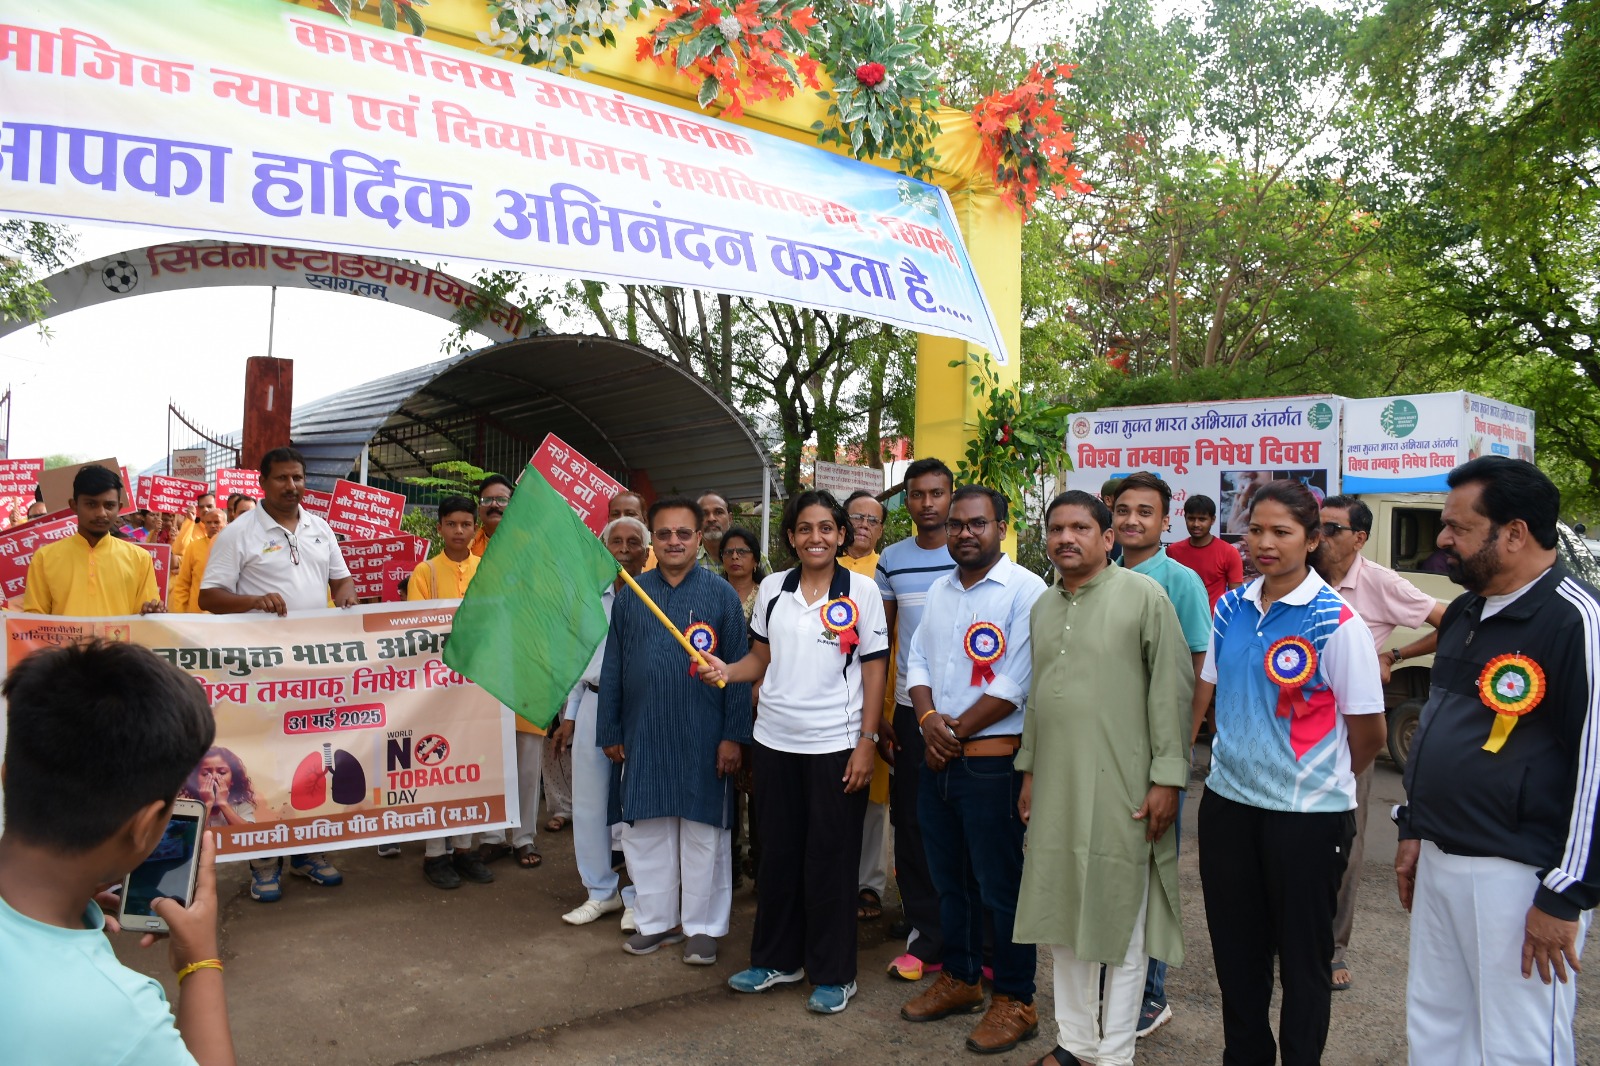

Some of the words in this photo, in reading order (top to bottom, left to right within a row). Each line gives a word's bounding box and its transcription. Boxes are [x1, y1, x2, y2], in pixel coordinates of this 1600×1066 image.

[290, 18, 516, 98] कार्यालय
[527, 75, 753, 156] उपसंचालक
[210, 68, 334, 125] न्याय
[347, 93, 420, 139] एवं
[432, 100, 649, 181] दिव्यांगजन
[251, 149, 472, 229] हार्दिक
[493, 182, 758, 272] अभिनंदन
[766, 235, 896, 300] करता
[1094, 420, 1118, 435] नशा
[1122, 417, 1152, 439] मुक्त
[1155, 416, 1188, 432] भारत
[1191, 409, 1248, 430] अभियान
[1251, 406, 1303, 428] अंतर्गत
[1077, 443, 1122, 469] विश्व
[1126, 445, 1191, 475] तम्बाकू
[1195, 437, 1254, 466] निषेध
[1259, 435, 1321, 464] दिवस
[1381, 442, 1398, 451] भारत
[547, 442, 570, 465] नशे
[570, 459, 588, 478] को
[589, 472, 619, 500] पहली
[550, 463, 574, 486] बार
[1348, 457, 1369, 472] विश्व
[1371, 457, 1400, 474] तम्बाकू
[1402, 452, 1427, 469] निषेध
[1429, 452, 1455, 468] दिवस
[155, 478, 189, 490] सिगरेट
[191, 482, 205, 492] को
[152, 494, 184, 505] जीवन
[335, 496, 353, 507] और
[386, 541, 404, 552] को
[390, 613, 452, 626] www.awgp
[292, 640, 367, 664] भारत
[257, 676, 345, 703] तम्बाकू
[352, 665, 416, 696] निषेध
[423, 659, 474, 688] दिव
[288, 716, 307, 731] 31
[312, 708, 337, 730] मई
[339, 708, 381, 727] 2025
[387, 729, 413, 739] WORLD
[387, 763, 480, 790] TOBACCO
[387, 789, 418, 806] DAY
[231, 824, 290, 847] गायत्री
[294, 819, 343, 841] शक्ति
[347, 814, 379, 833] पीठ
[382, 807, 436, 829] सिवनी
[440, 801, 491, 826] (म.प्र.)
